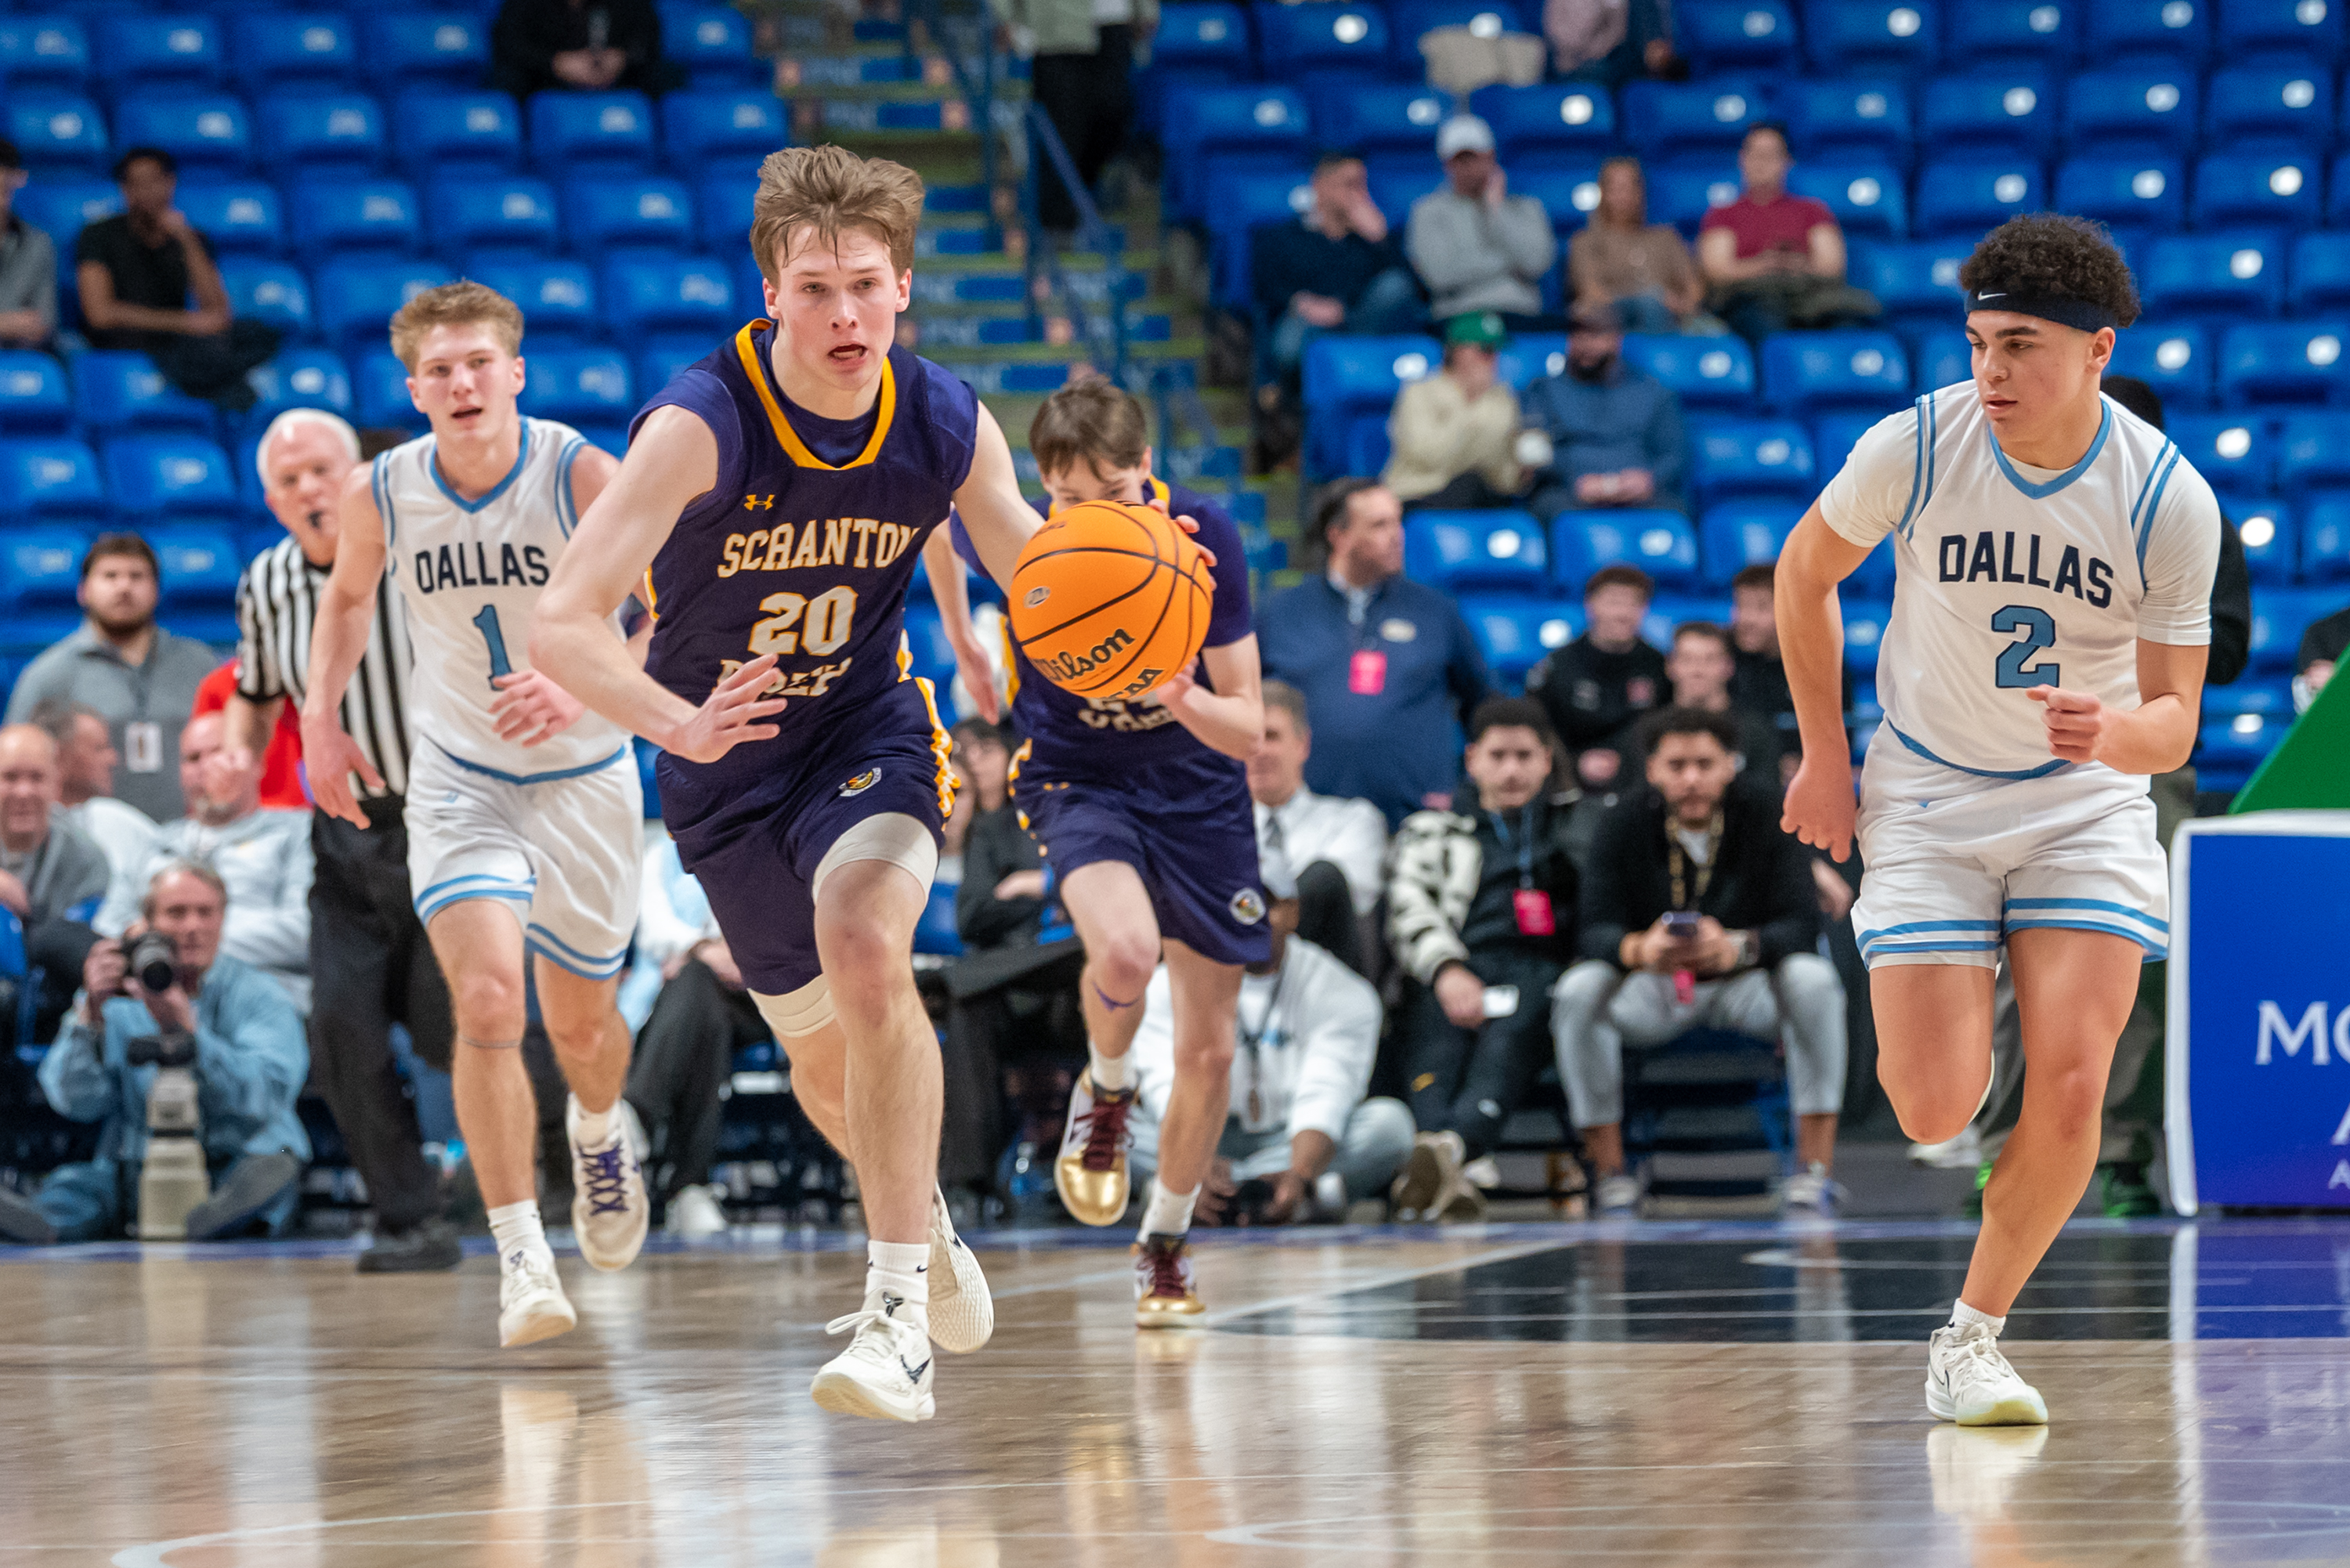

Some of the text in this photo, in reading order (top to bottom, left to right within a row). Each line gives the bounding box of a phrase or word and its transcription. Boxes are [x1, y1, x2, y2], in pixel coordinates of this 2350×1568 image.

[415, 542, 550, 594] DALLAS
[1939, 530, 2114, 609] DALLAS
[472, 604, 513, 692] 1
[747, 585, 859, 656] 20
[1990, 604, 2060, 688] 2
[2255, 999, 2350, 1066] M
